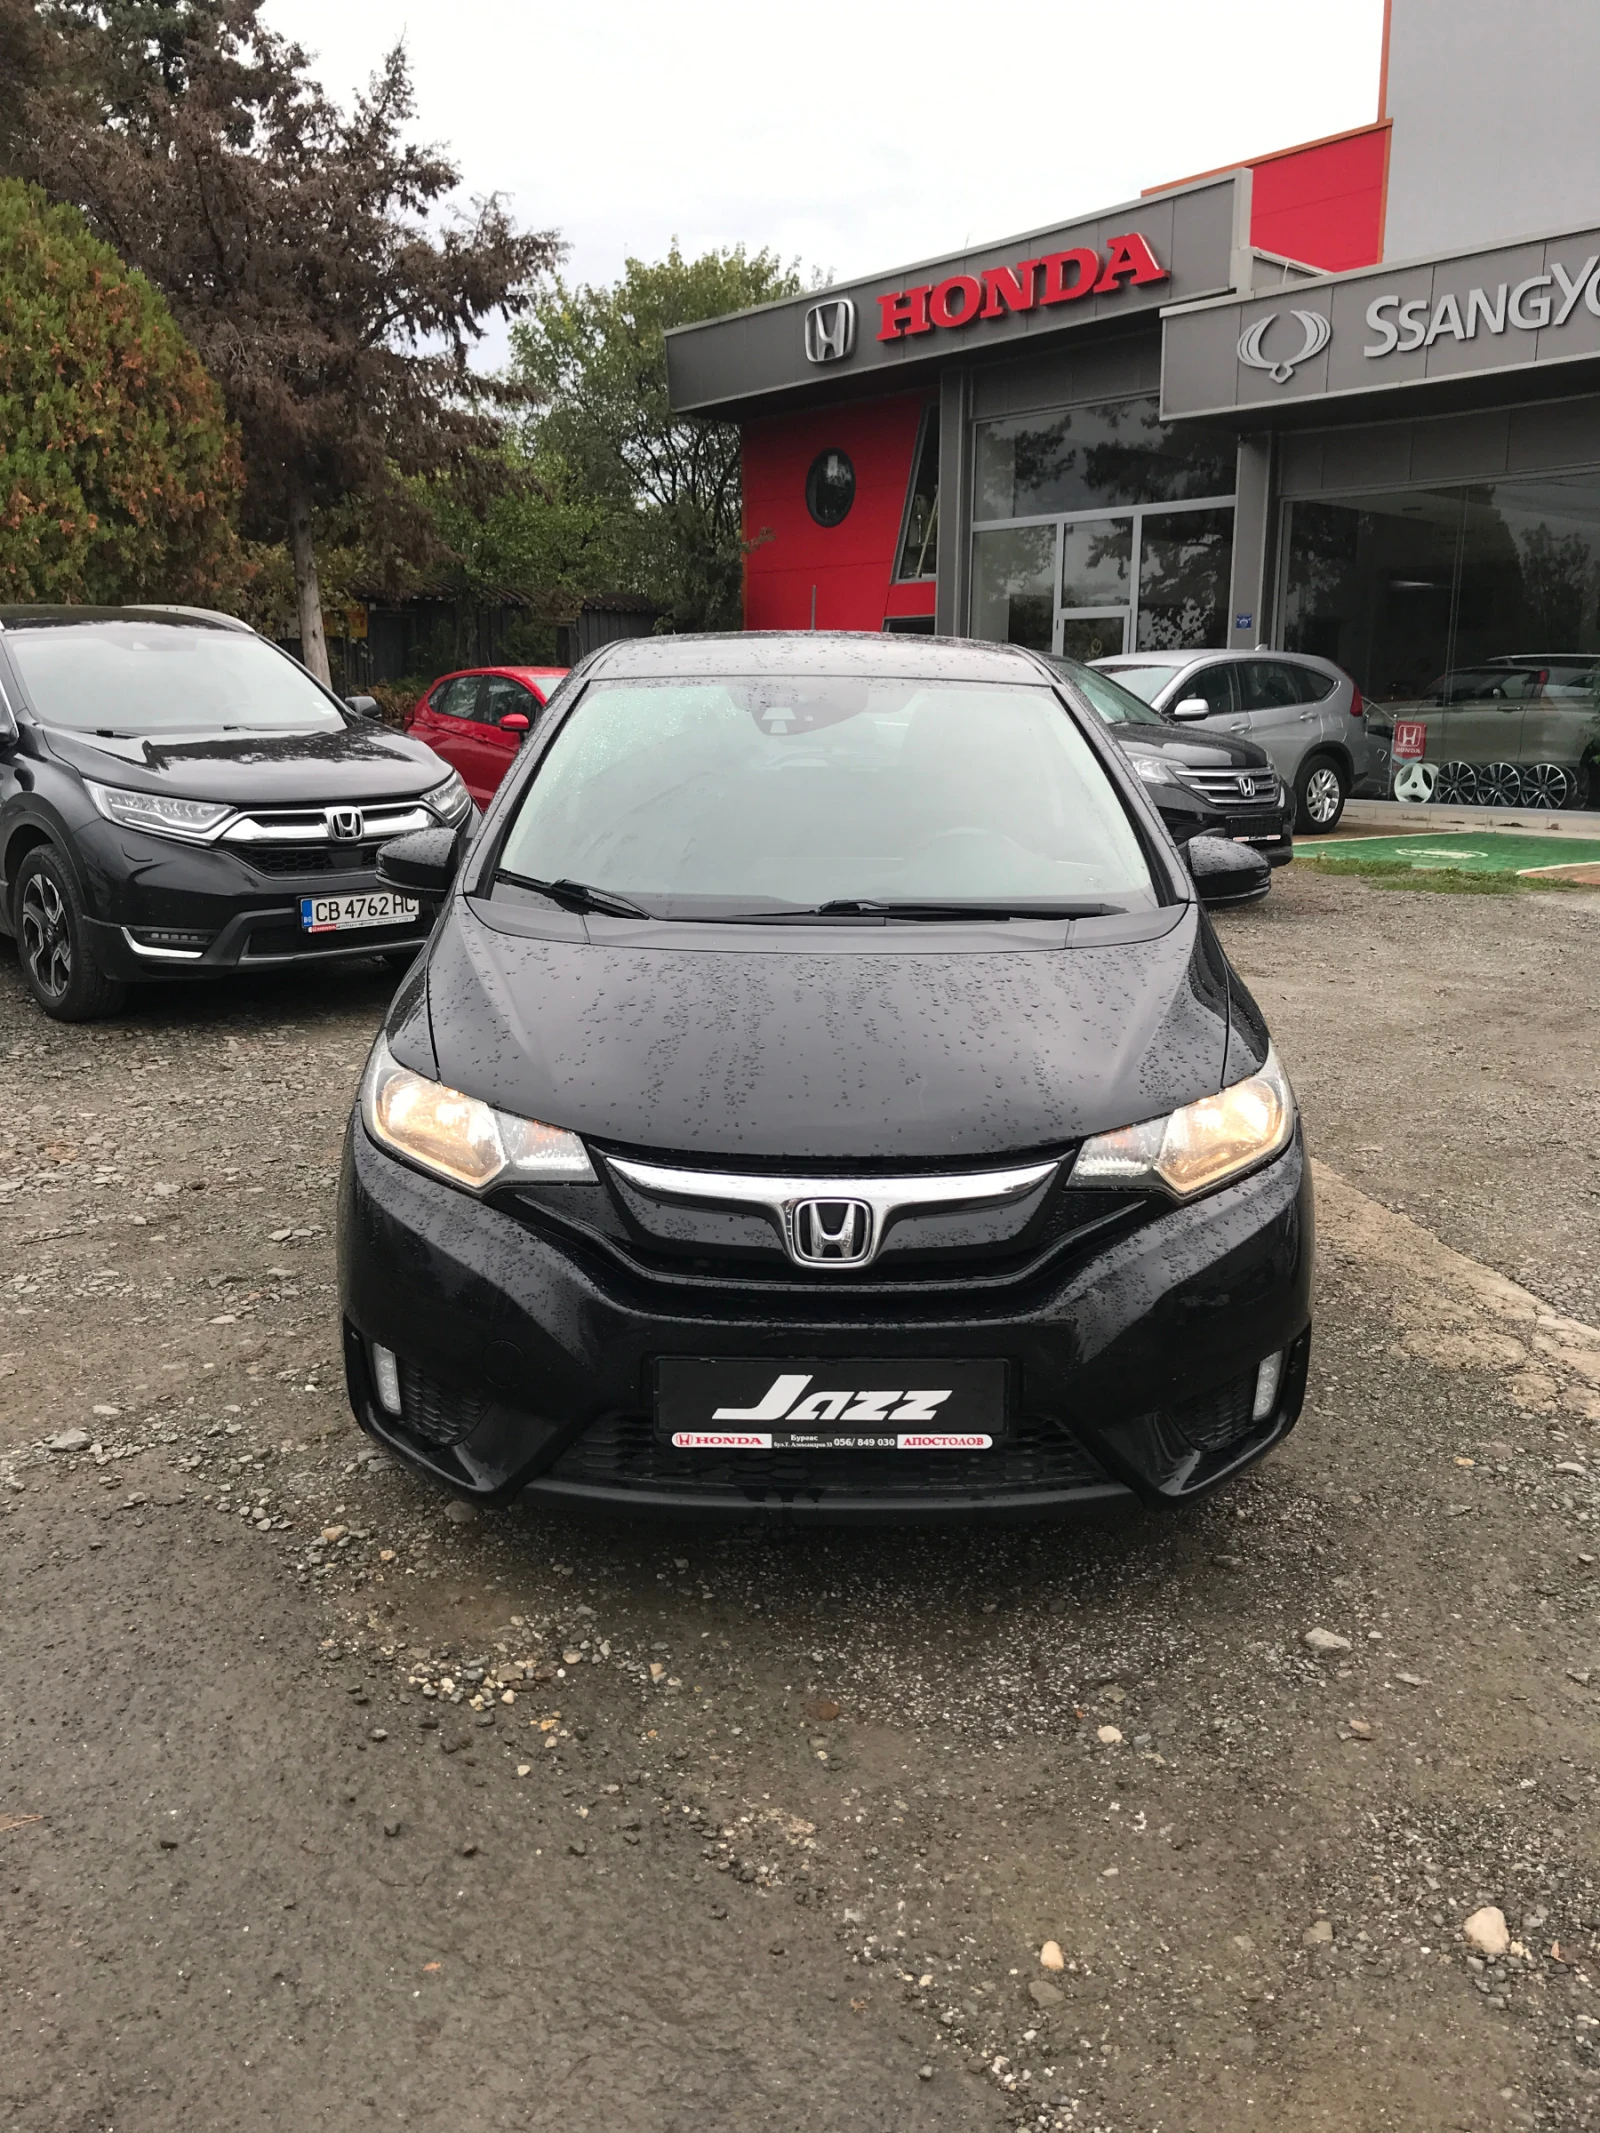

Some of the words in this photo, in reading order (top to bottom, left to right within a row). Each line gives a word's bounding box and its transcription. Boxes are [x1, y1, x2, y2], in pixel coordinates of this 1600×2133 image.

[876, 231, 1168, 341] HONDA
[315, 901, 340, 922] CB
[344, 896, 389, 919] 4762
[695, 1436, 763, 1445] HONDA
[833, 1438, 855, 1447] 056/
[857, 1438, 875, 1446] 849
[877, 1438, 895, 1446] 030
[903, 1437, 984, 1446] АПОСТОЛОВ
